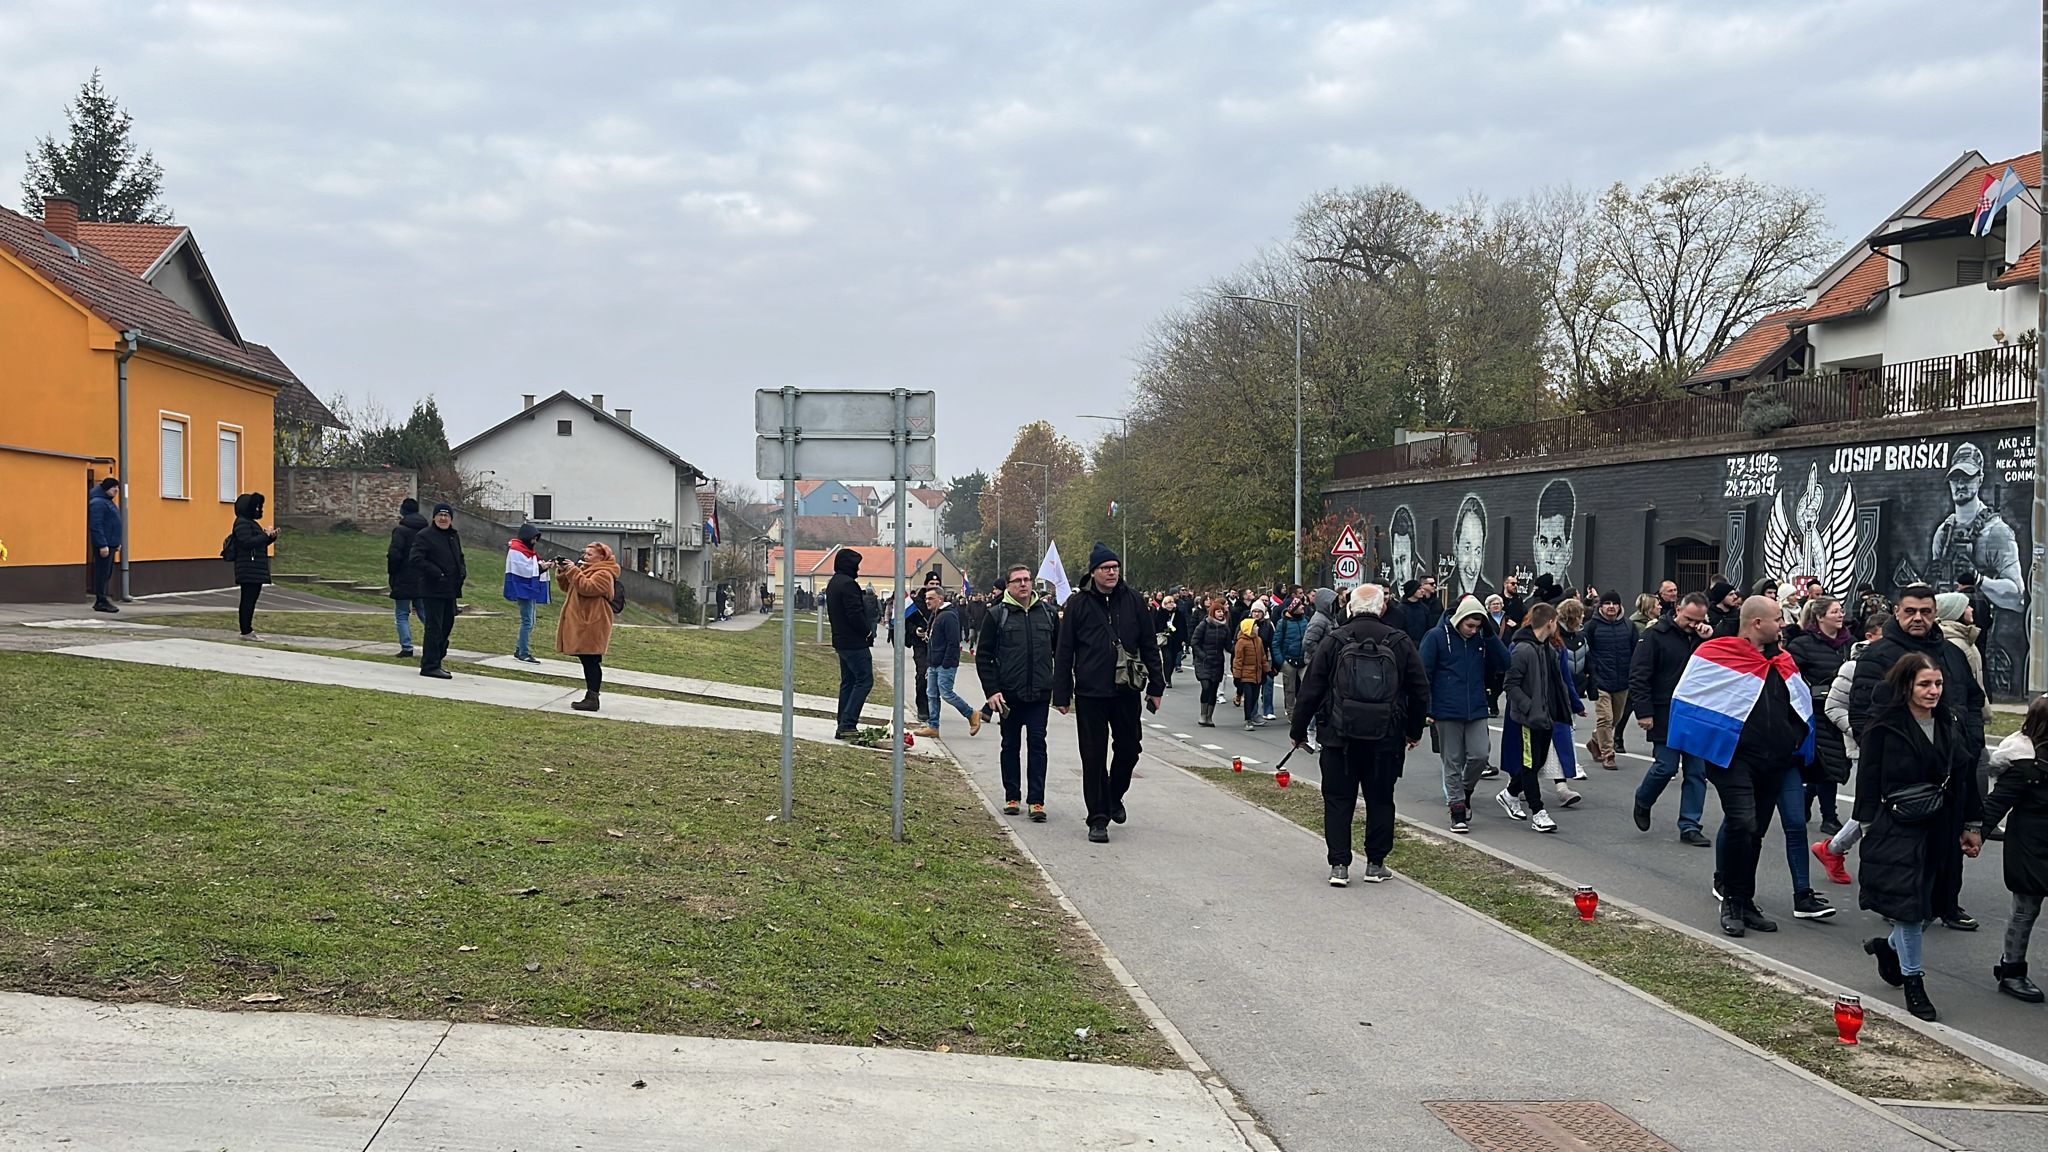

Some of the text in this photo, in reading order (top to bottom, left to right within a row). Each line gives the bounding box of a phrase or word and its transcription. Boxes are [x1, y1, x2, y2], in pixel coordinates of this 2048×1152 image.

[1997, 436, 2031, 450] AKO JE
[1726, 452, 1783, 477] 7.3.1992.
[1829, 438, 1949, 474] JOSIP BRIŠKI
[1995, 459, 2017, 469] NEKA
[1724, 473, 1777, 498] 24.7.2019.
[1341, 560, 1355, 573] 40
